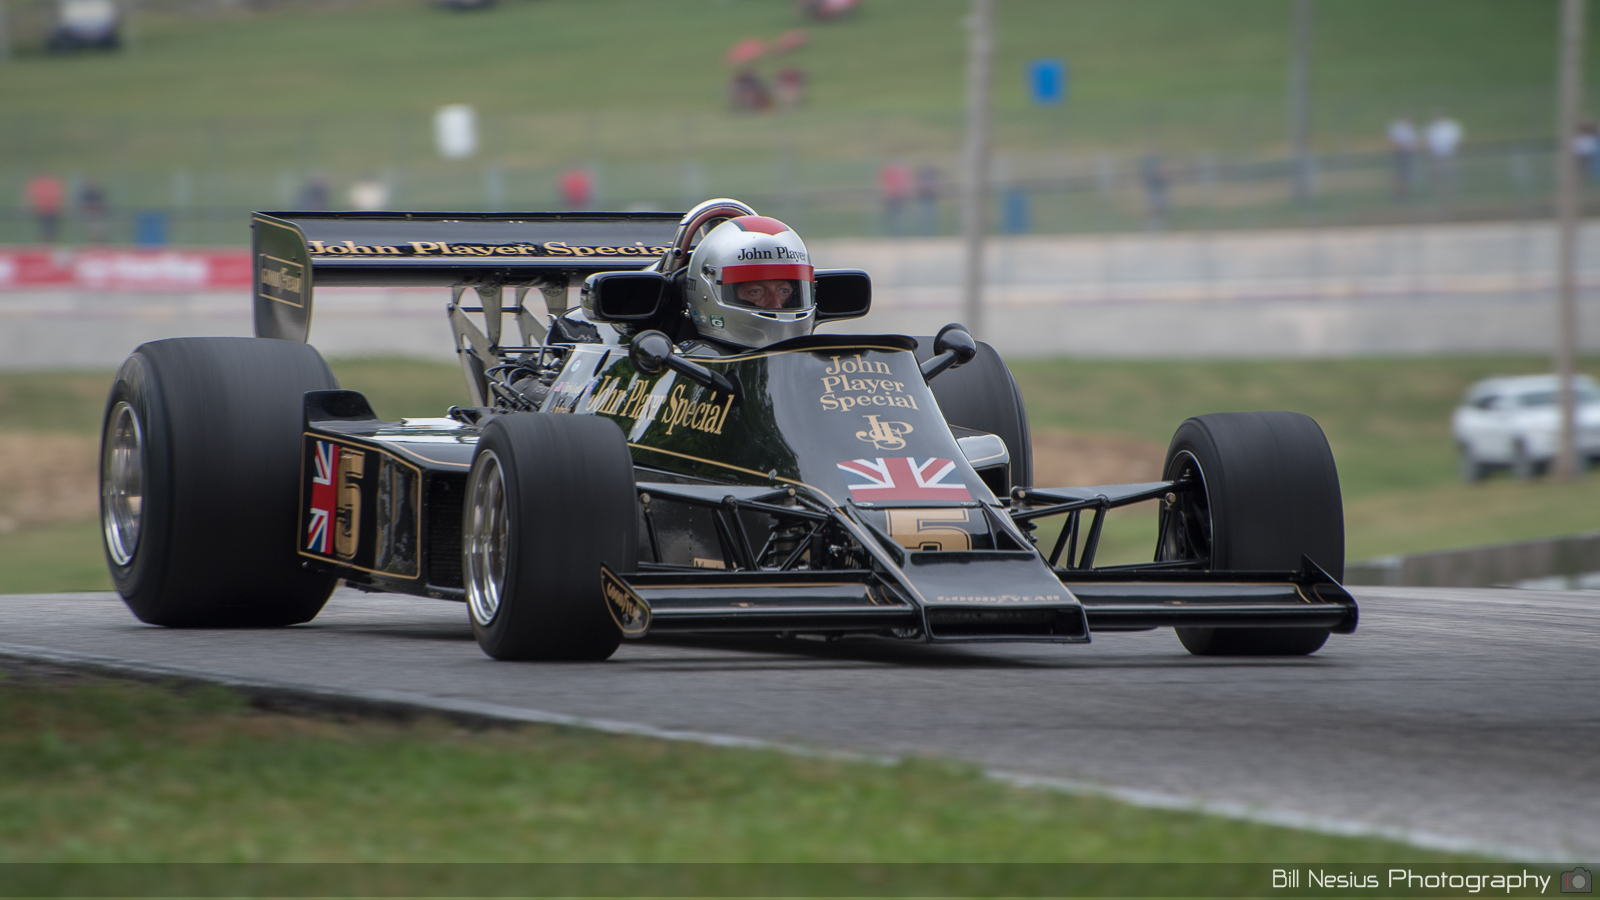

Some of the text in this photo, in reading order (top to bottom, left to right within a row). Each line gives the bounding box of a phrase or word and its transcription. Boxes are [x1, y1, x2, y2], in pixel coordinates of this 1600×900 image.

[307, 240, 673, 257] John Player Specia
[738, 246, 807, 262] John Player
[825, 354, 893, 375] John
[820, 374, 904, 394] Player
[585, 375, 735, 435] John Player Special
[819, 391, 920, 412] Special
[336, 447, 366, 559] 5
[884, 508, 973, 552] 5
